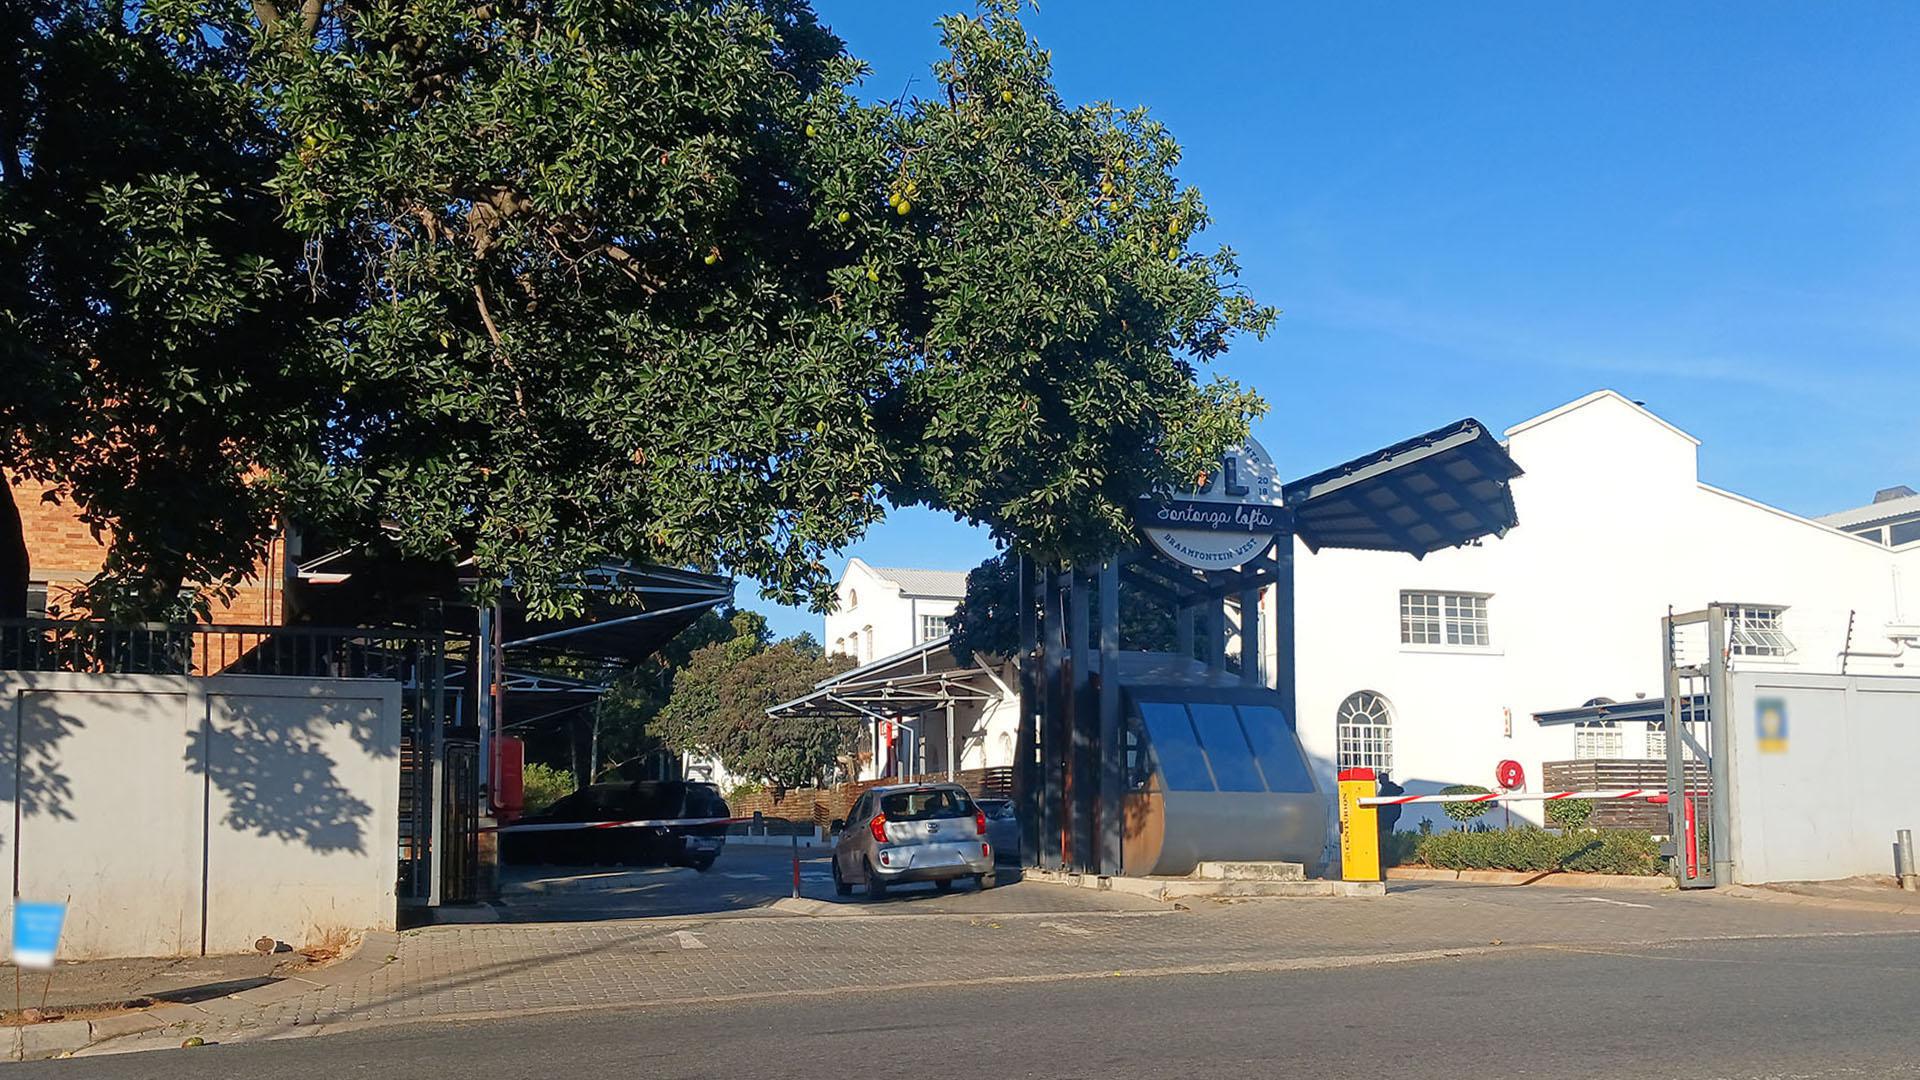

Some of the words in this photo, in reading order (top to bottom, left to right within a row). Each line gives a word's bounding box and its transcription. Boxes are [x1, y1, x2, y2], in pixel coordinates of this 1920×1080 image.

[1236, 506, 1273, 531] lofts
[1164, 533, 1234, 561] BRAAMFONTEIN
[1235, 537, 1257, 556] WEST
